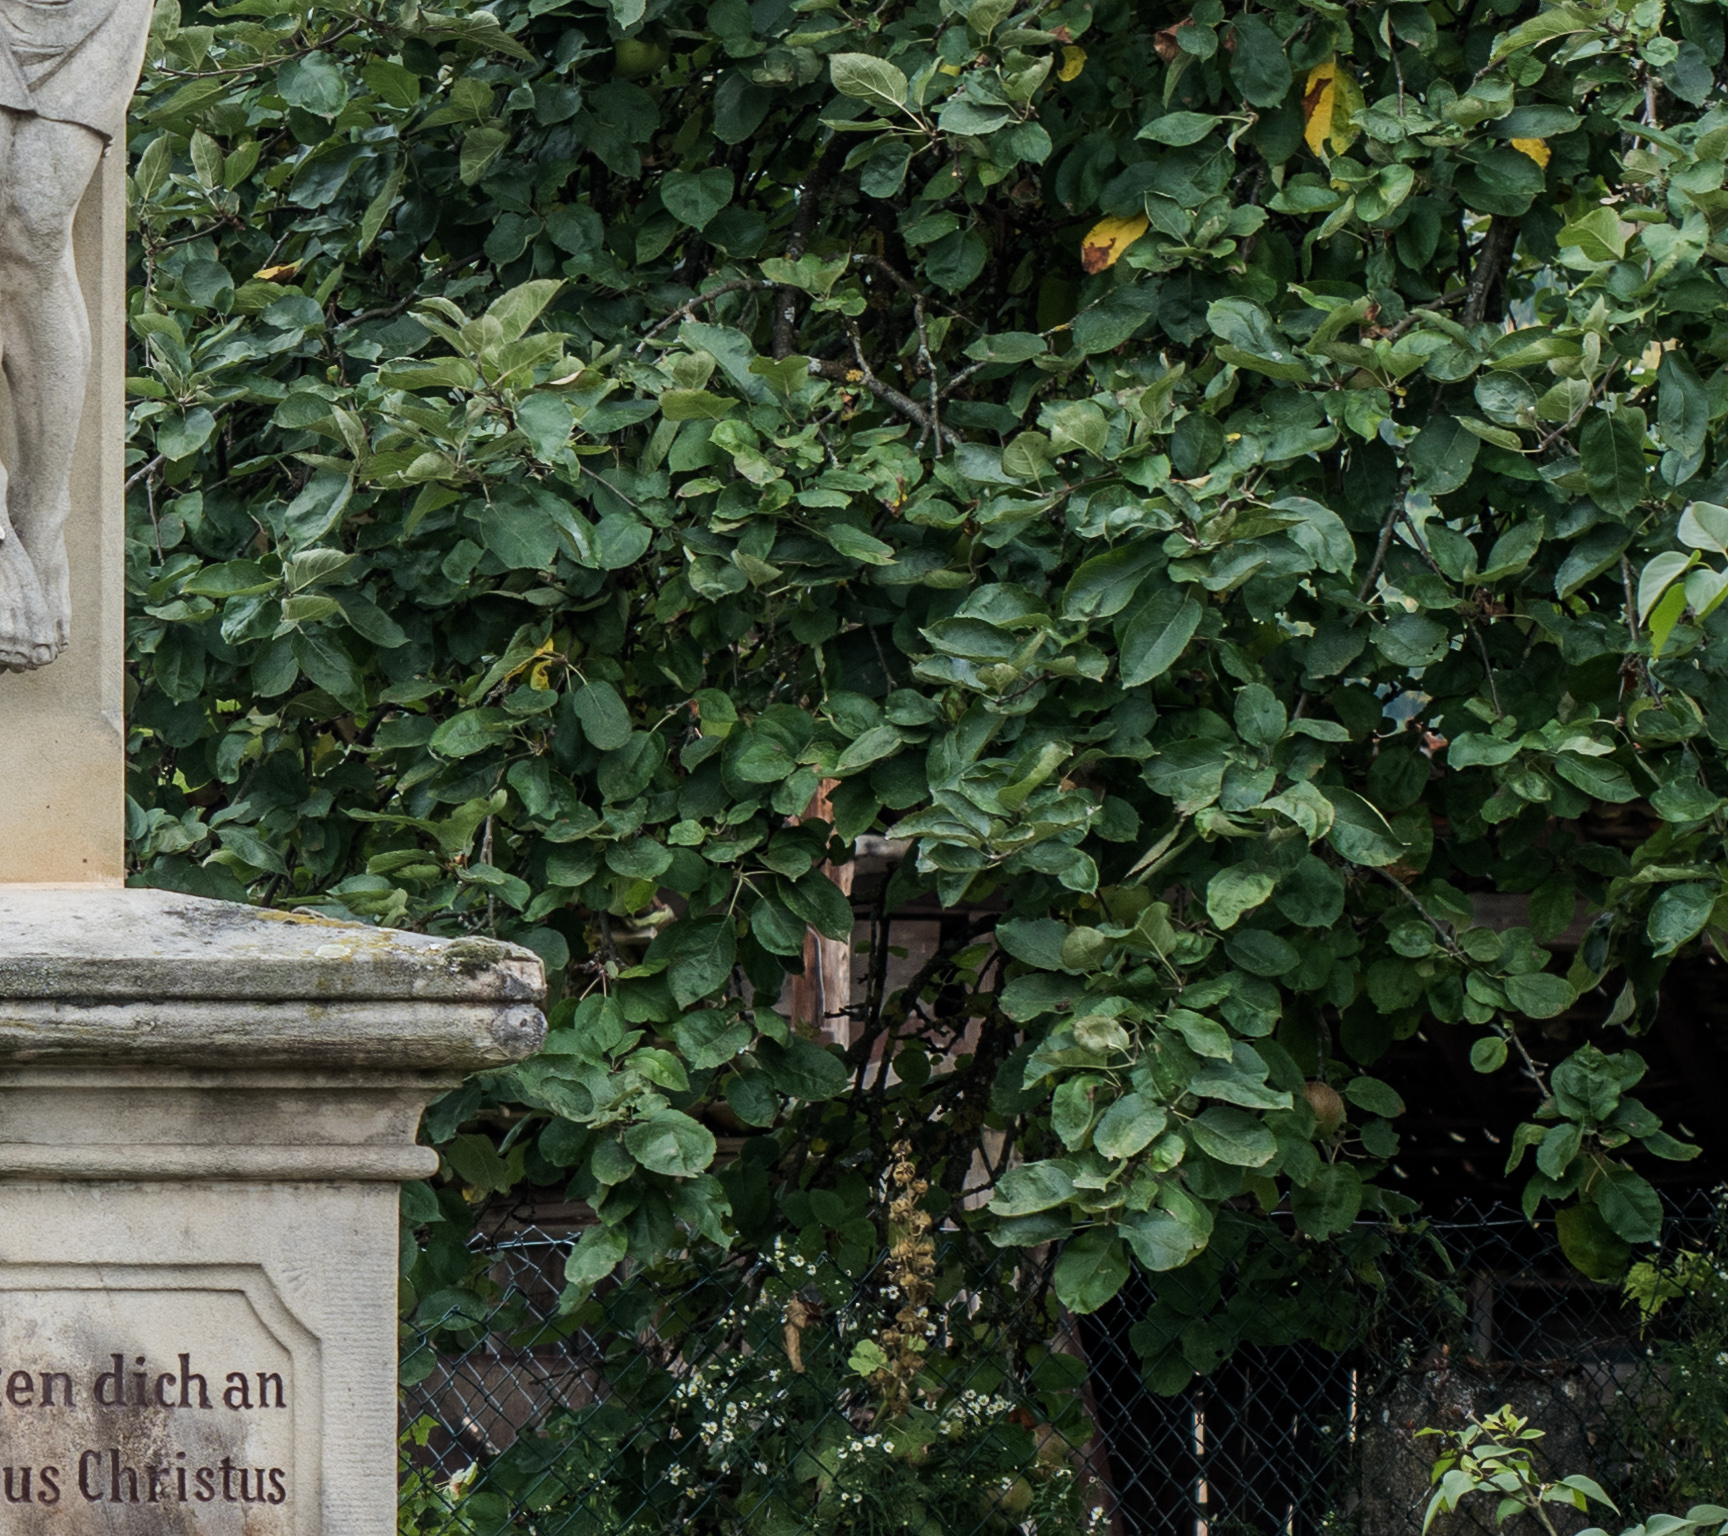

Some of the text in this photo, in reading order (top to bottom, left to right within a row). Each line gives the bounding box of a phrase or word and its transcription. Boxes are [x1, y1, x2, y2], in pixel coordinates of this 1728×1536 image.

[93, 1353, 213, 1409] dich
[222, 1370, 286, 1411] an
[78, 1448, 286, 1505] Christus
